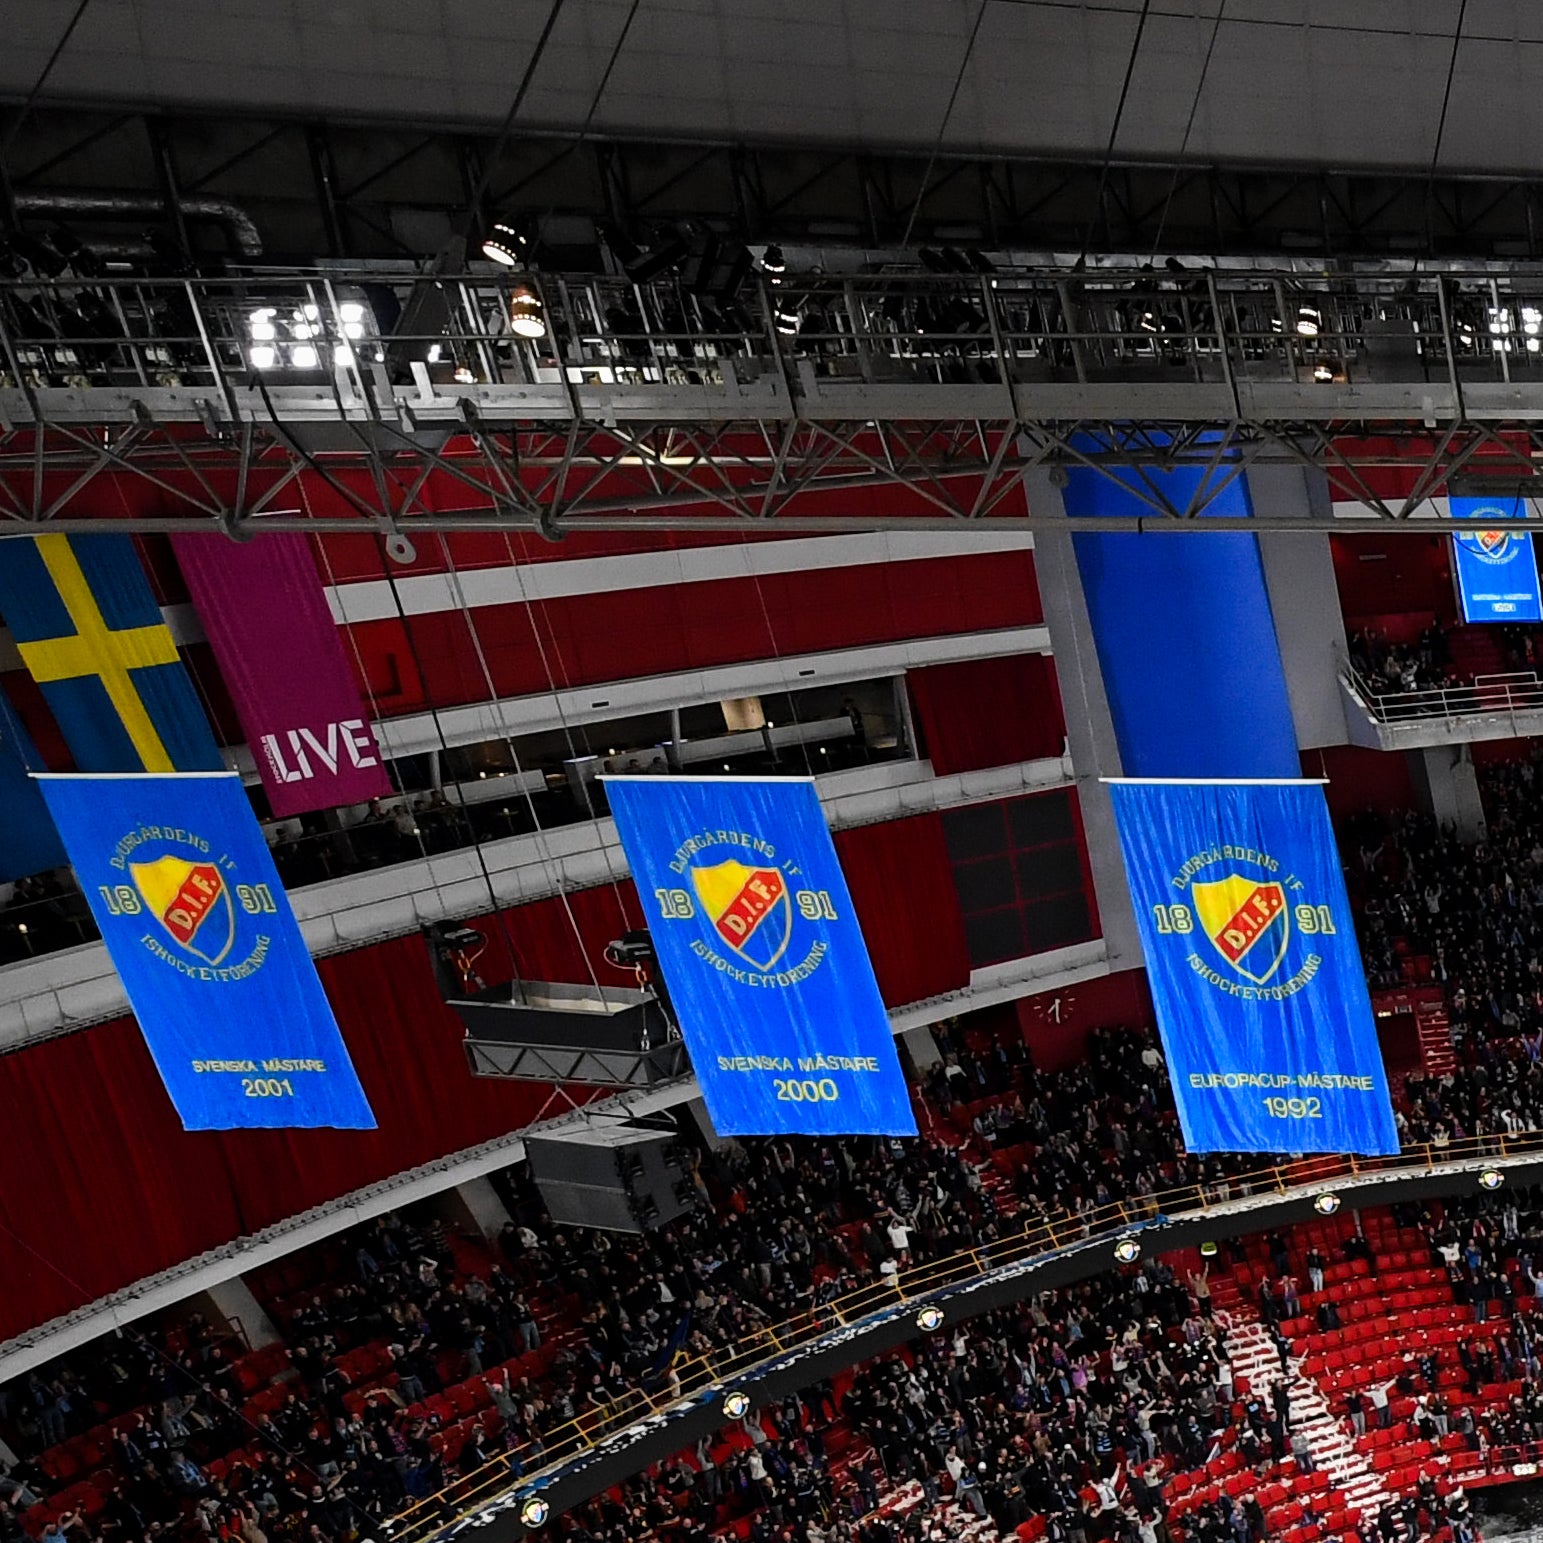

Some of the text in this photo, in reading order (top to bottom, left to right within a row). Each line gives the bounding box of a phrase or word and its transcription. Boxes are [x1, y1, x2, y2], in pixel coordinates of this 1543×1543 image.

[266, 720, 377, 783] LIVE
[99, 884, 276, 916] 18 91
[655, 889, 838, 920] 18 91
[1154, 904, 1337, 935] 18 91
[191, 1057, 326, 1073] SVENSKA MÄSTARE
[718, 1053, 880, 1072] SVENSKA MÄSTARE
[242, 1079, 294, 1098] 2001
[774, 1079, 839, 1103] 2000
[1263, 1096, 1323, 1118] 1992
